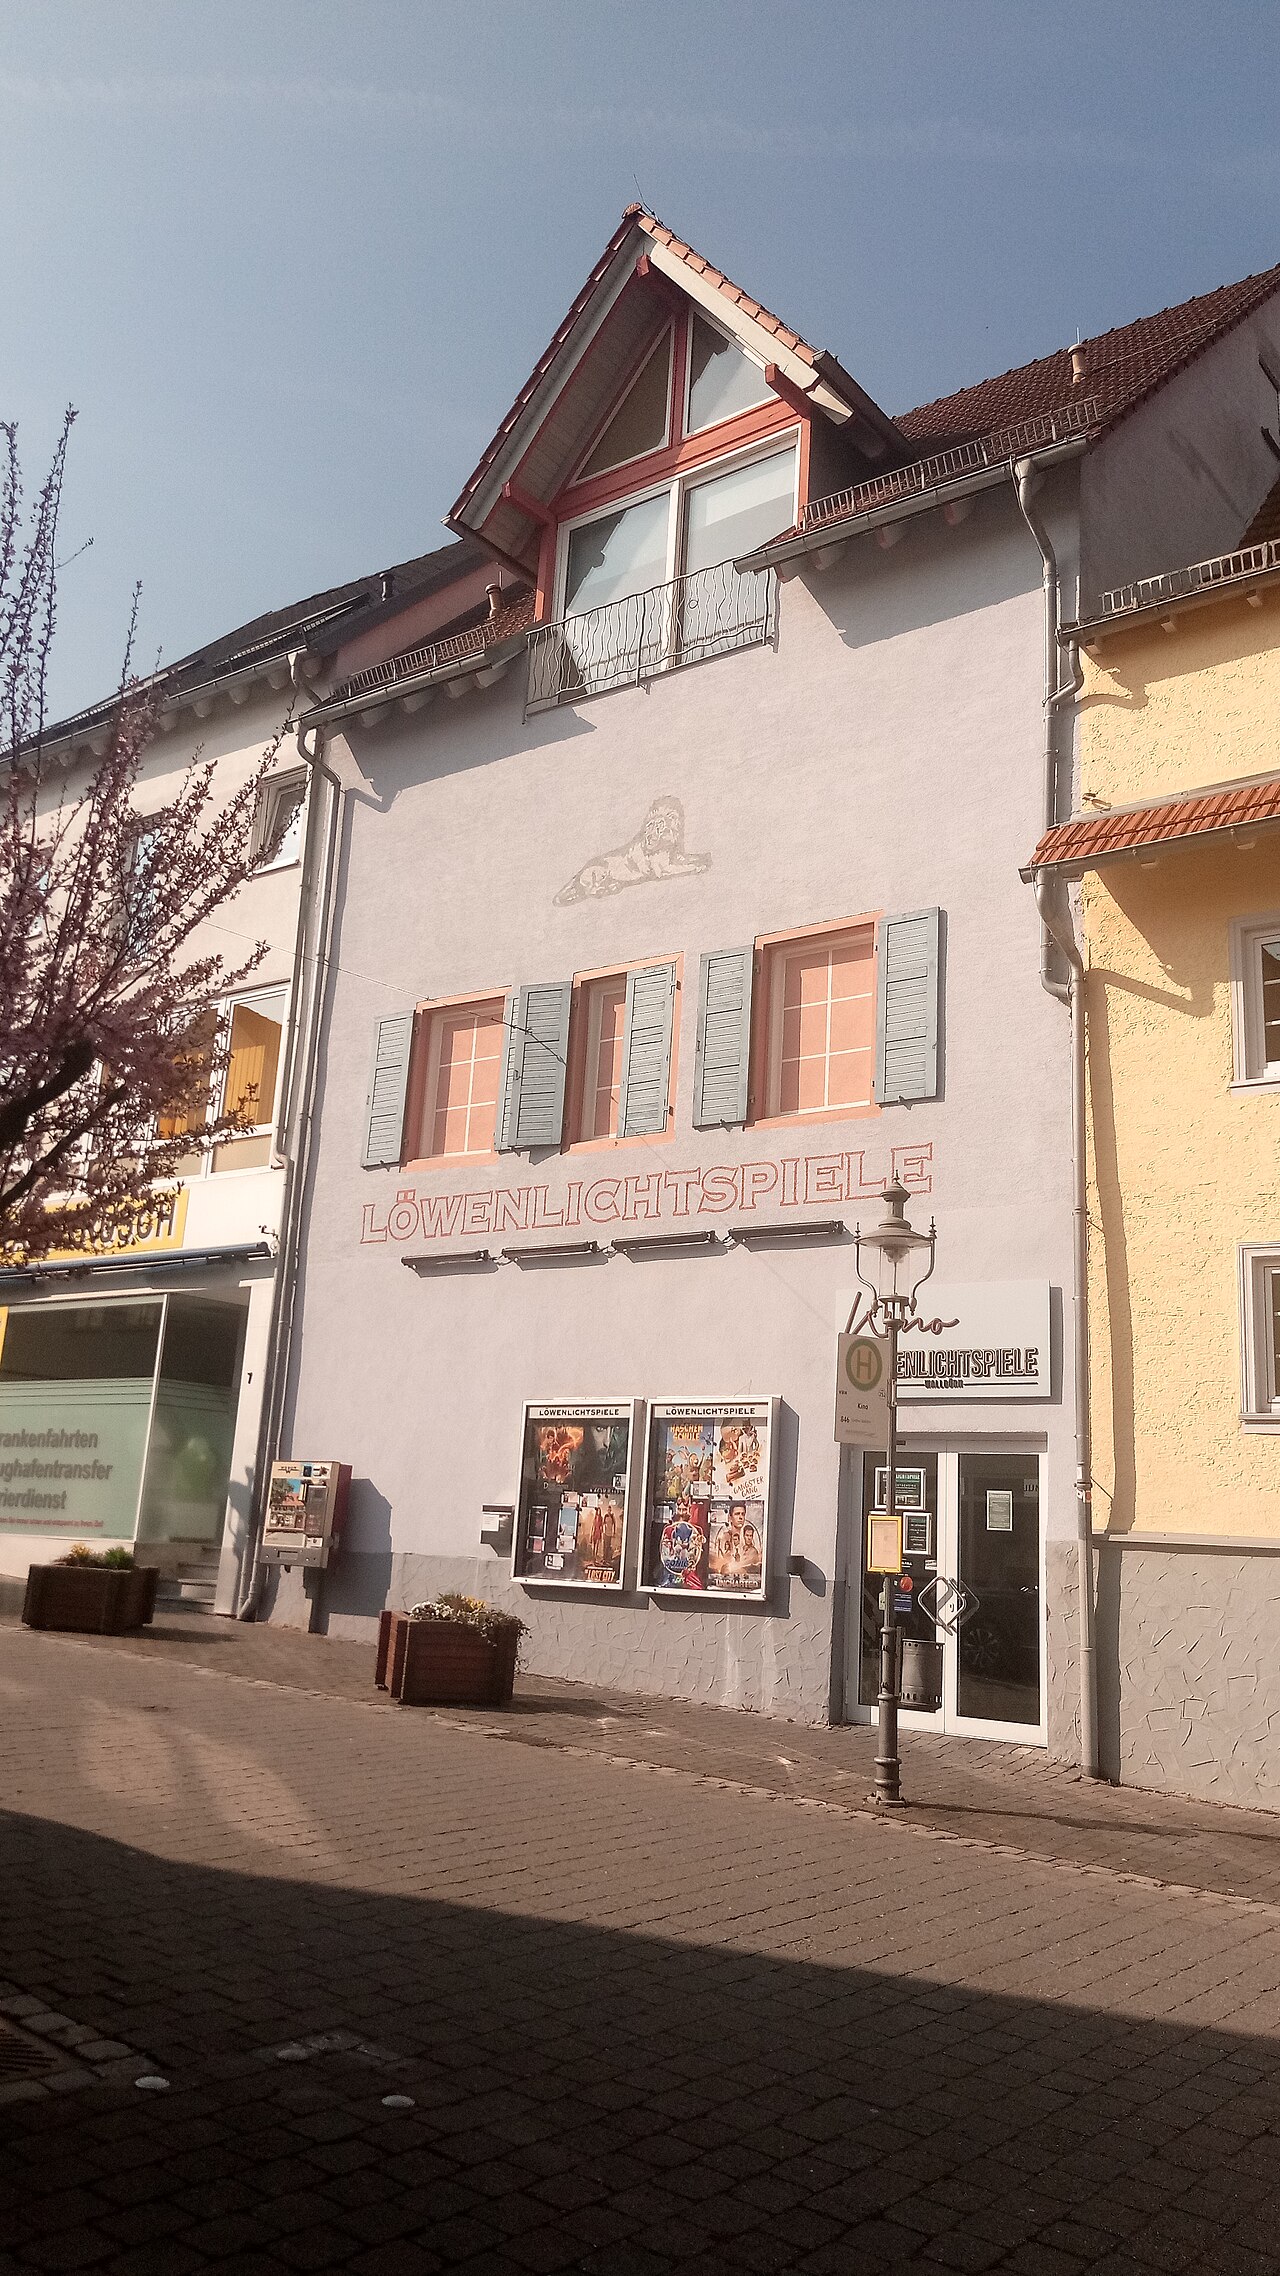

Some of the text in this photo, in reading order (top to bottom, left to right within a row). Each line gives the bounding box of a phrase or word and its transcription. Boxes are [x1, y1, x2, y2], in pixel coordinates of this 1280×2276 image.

[360, 1142, 933, 1245] LÖWENLICHTSPIELE
[539, 1407, 620, 1416] LÖWENLICHTSPIELE
[665, 1405, 756, 1416] LÖWENLICHTSPIELE
[733, 1477, 764, 1495] GANGSTER
[741, 1487, 758, 1498] GANG
